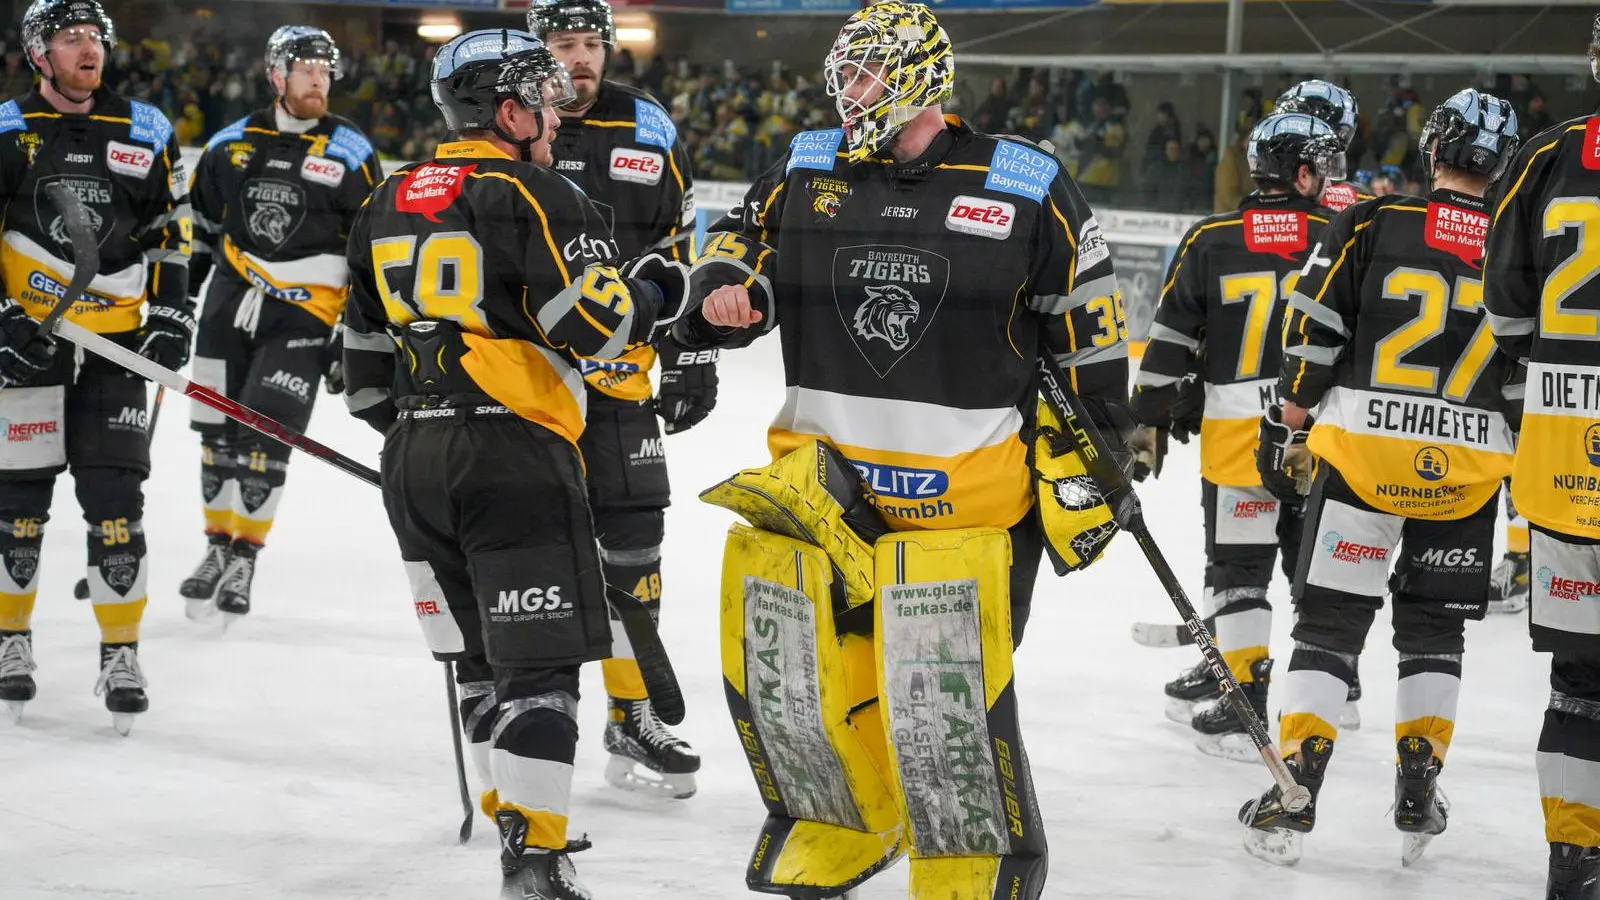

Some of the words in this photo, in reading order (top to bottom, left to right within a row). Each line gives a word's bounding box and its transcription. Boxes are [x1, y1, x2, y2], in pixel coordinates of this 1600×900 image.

[795, 141, 835, 151] ERKE
[1478, 135, 1497, 147] 27
[613, 156, 661, 174] DEL2
[1000, 144, 1055, 171] STADT
[996, 156, 1050, 185] WERKE
[812, 181, 849, 194] TIGERS
[991, 173, 1045, 197] Bayreuth
[246, 187, 300, 206] TIGERS
[951, 204, 1011, 227] DEL2
[1252, 213, 1298, 225] REWE
[1437, 207, 1489, 228] REWE
[1253, 223, 1298, 234] HEINISCH
[1254, 234, 1272, 244] Dein
[1274, 232, 1298, 243] Markt
[1435, 230, 1455, 243] Dein
[1458, 234, 1486, 248] Markt
[1436, 221, 1488, 236] HEINISCH
[868, 250, 920, 264] BAYREUTH
[848, 259, 931, 284] TIGERS
[1371, 266, 1499, 400] 27
[271, 369, 311, 398] MGS
[8, 420, 57, 435] HERTEL
[1367, 398, 1490, 445] SCHAEFER
[248, 450, 267, 473] 11
[818, 446, 827, 488] MACH
[101, 516, 130, 546] 96
[1335, 540, 1389, 561] HERTEL
[1421, 548, 1478, 568] MGS
[633, 572, 661, 602] 48
[891, 583, 975, 602] www.glas-
[497, 585, 562, 614] MGS
[897, 600, 974, 618] farkas.de
[1444, 602, 1480, 611] BAUER
[513, 613, 544, 621] GRUPPE
[757, 600, 812, 624] farkas.de
[1186, 618, 1234, 694] BAUER
[736, 717, 781, 802] BAUER
[938, 671, 999, 853] FARKAS
[994, 736, 1024, 838] BAUER
[752, 833, 772, 872] MACH
